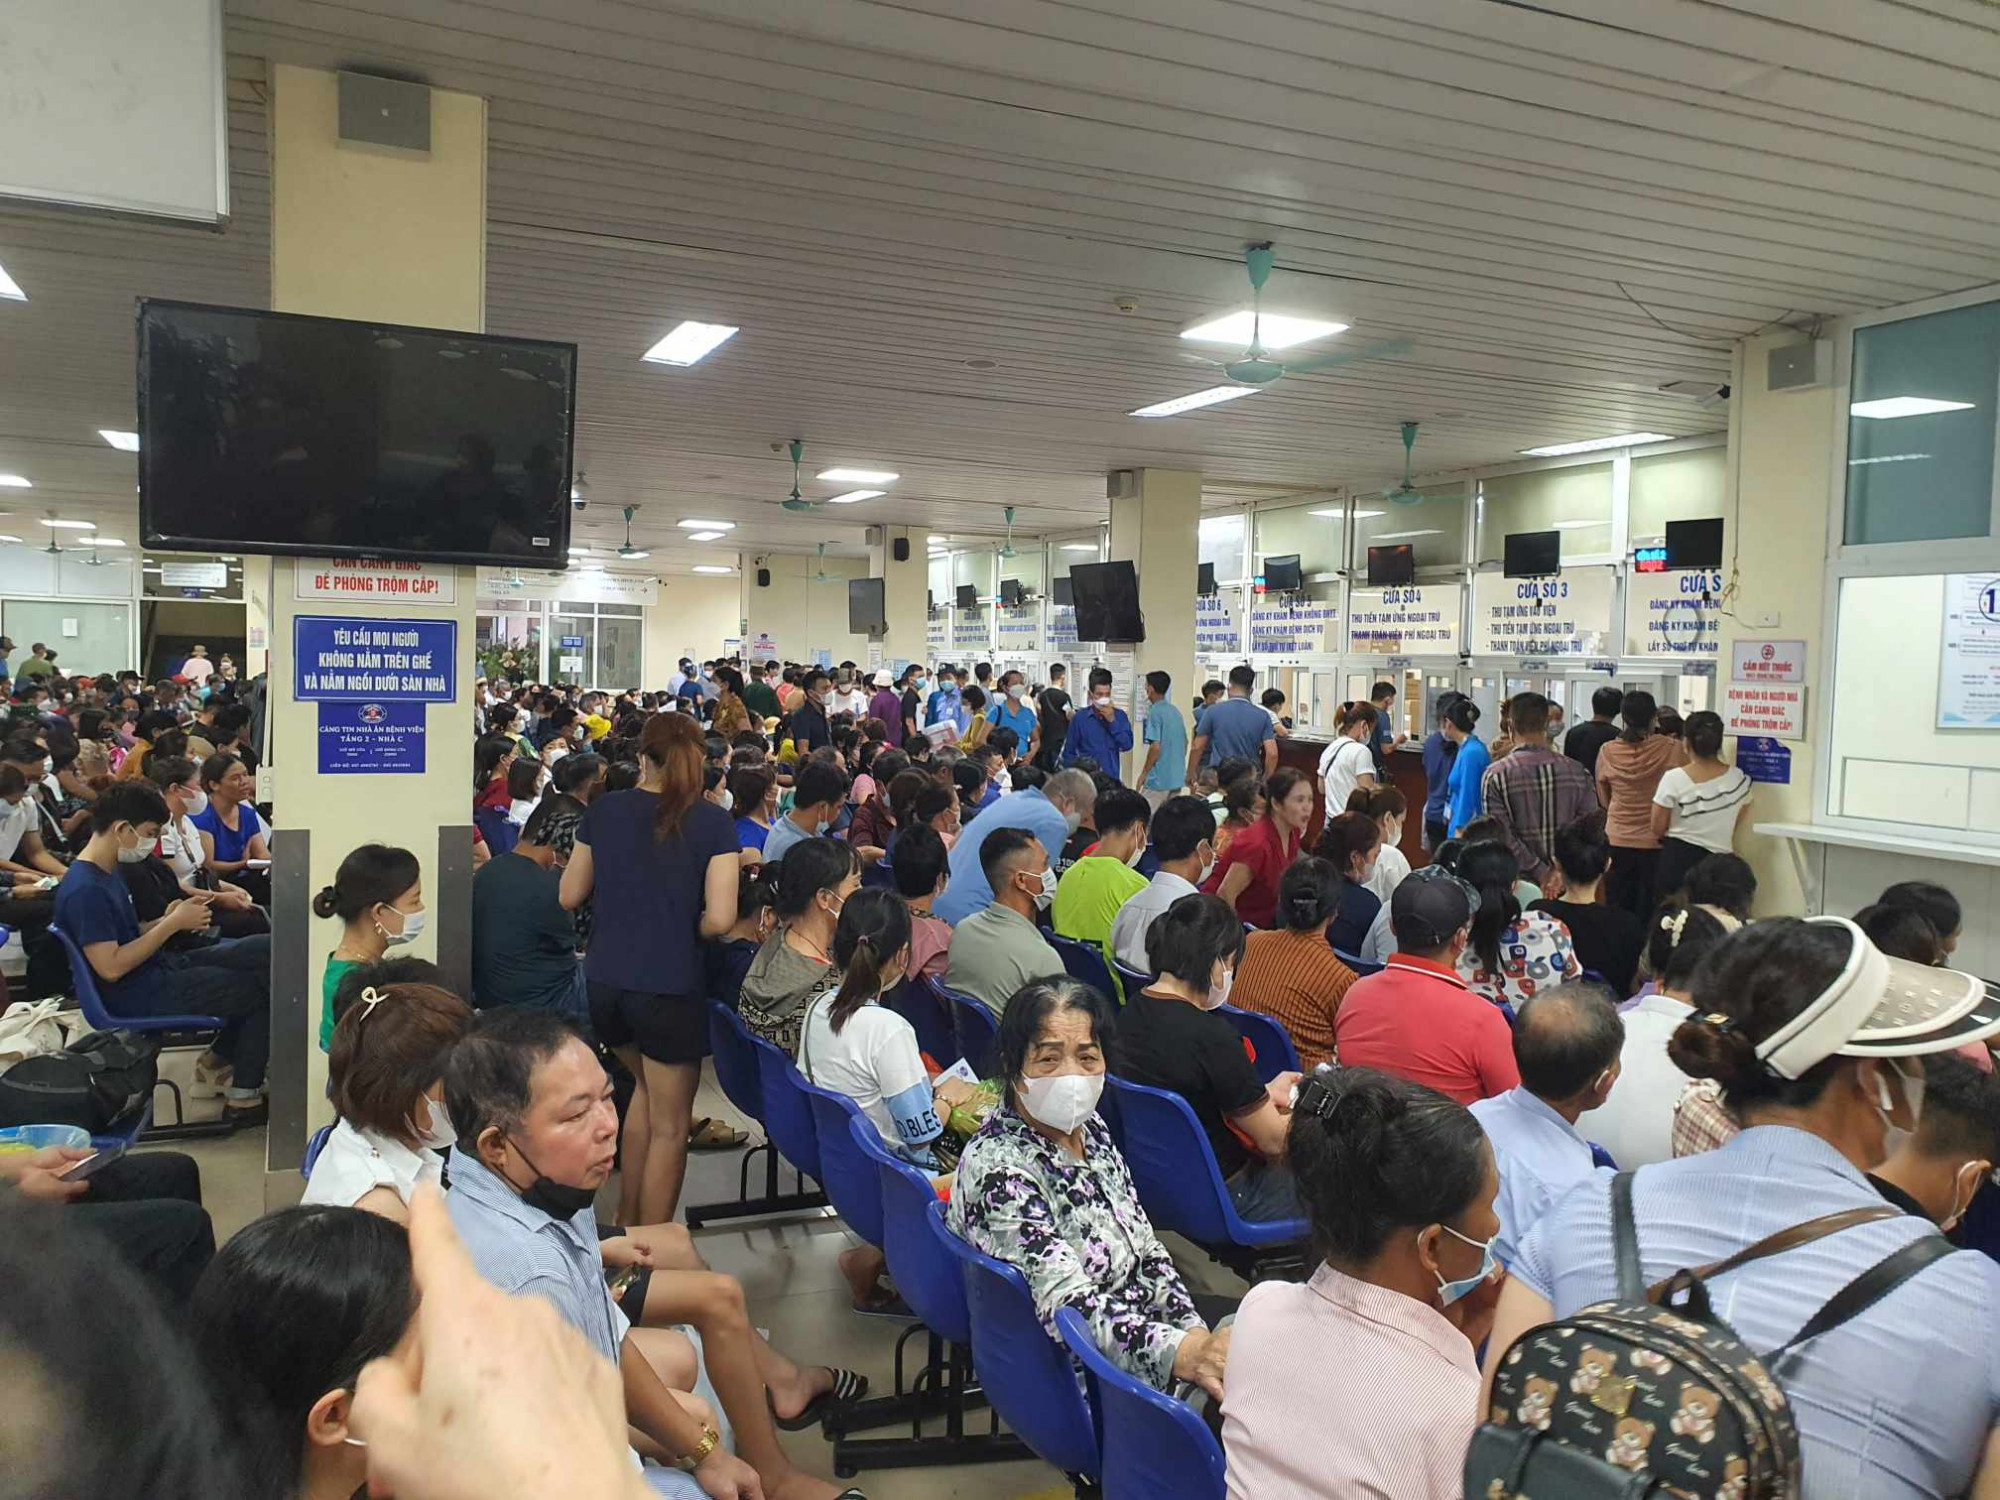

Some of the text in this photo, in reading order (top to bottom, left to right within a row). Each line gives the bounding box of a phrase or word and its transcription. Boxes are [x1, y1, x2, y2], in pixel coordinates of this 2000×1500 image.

[376, 575, 409, 596] TRỘM
[1560, 582, 1568, 598] 3
[1985, 588, 1996, 614] 1
[333, 627, 351, 645] YÊU
[373, 631, 390, 650] MỌI
[392, 629, 419, 647] NGƯỜI
[318, 650, 354, 668] KHÔNG
[383, 652, 409, 669] TRÊN
[412, 650, 433, 669] GHẾ
[304, 672, 318, 690] VÀ
[375, 673, 399, 691] DƯỚI
[401, 674, 423, 691] SÀN
[425, 674, 446, 692] NHÀ
[356, 725, 373, 733] NHÀ
